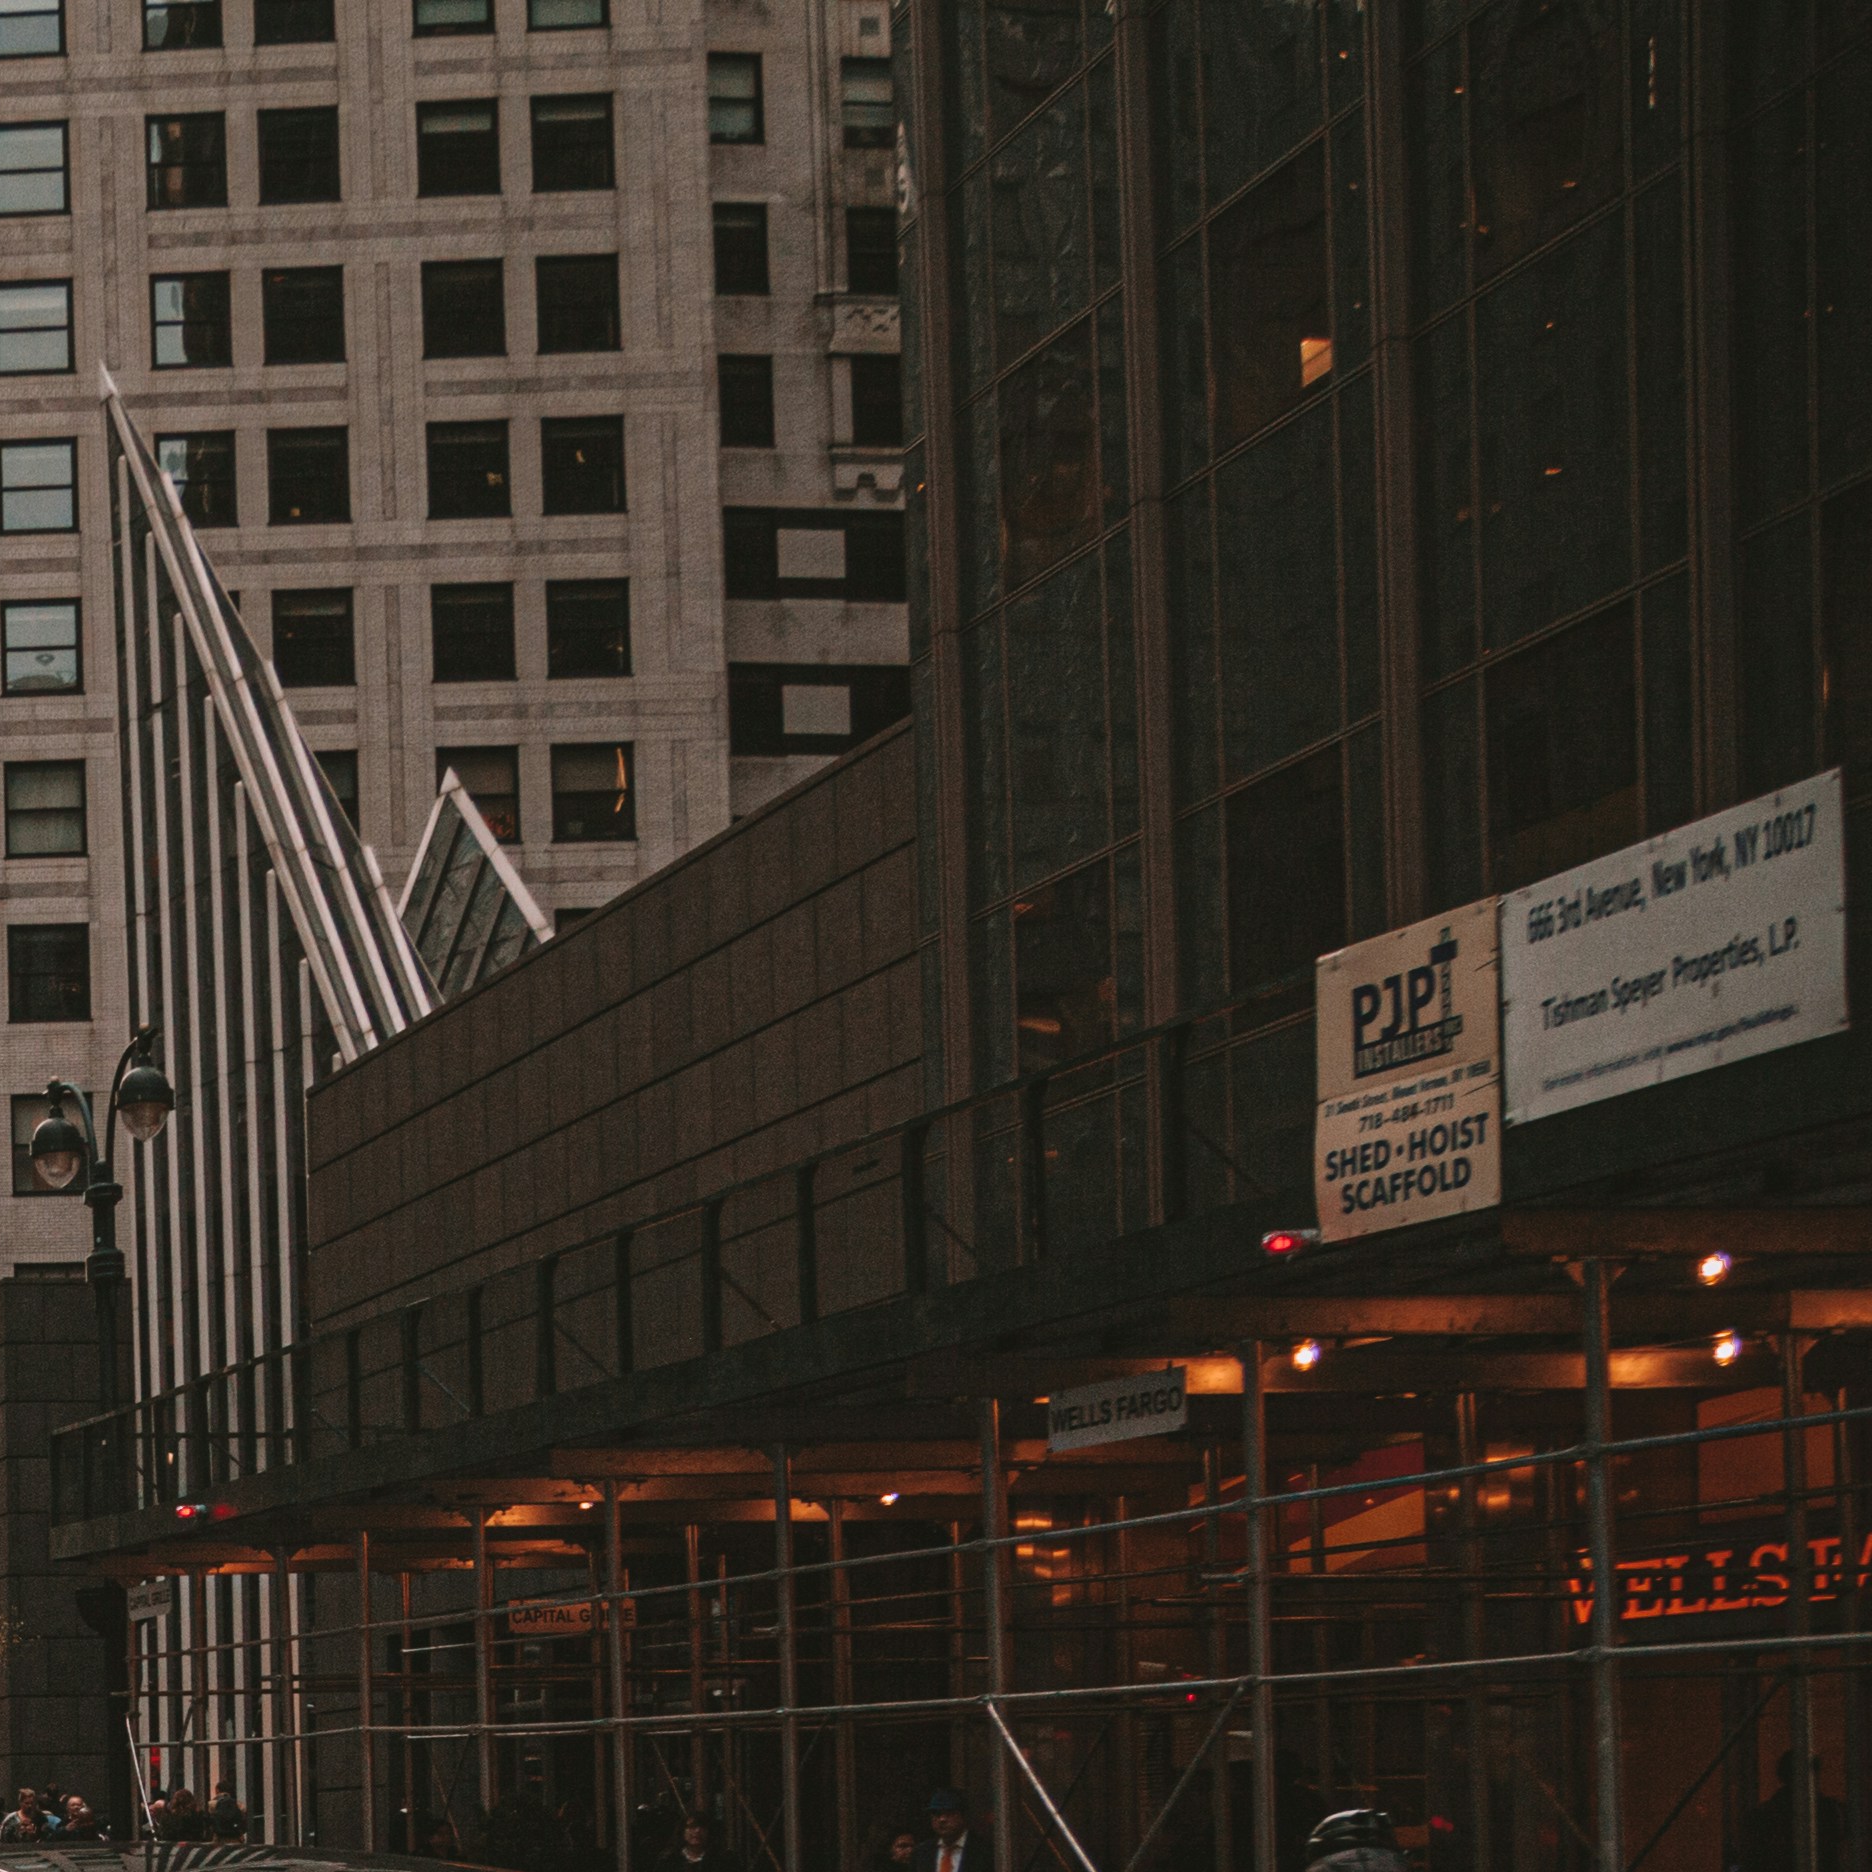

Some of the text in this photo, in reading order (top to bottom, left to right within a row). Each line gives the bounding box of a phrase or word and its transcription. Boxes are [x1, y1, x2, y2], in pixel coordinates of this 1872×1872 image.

[1652, 859, 1687, 898] New
[1733, 823, 1759, 869] NY
[1762, 803, 1816, 860] 10017
[1352, 965, 1437, 1050] PJP
[1325, 1112, 1489, 1182] SHED HOIST
[1342, 1157, 1472, 1214] SCAFFOLD
[1051, 1386, 1183, 1433] WELLS FARGO
[511, 1609, 576, 1623] CAPITAL
[1567, 1543, 1791, 1625] WELLS
